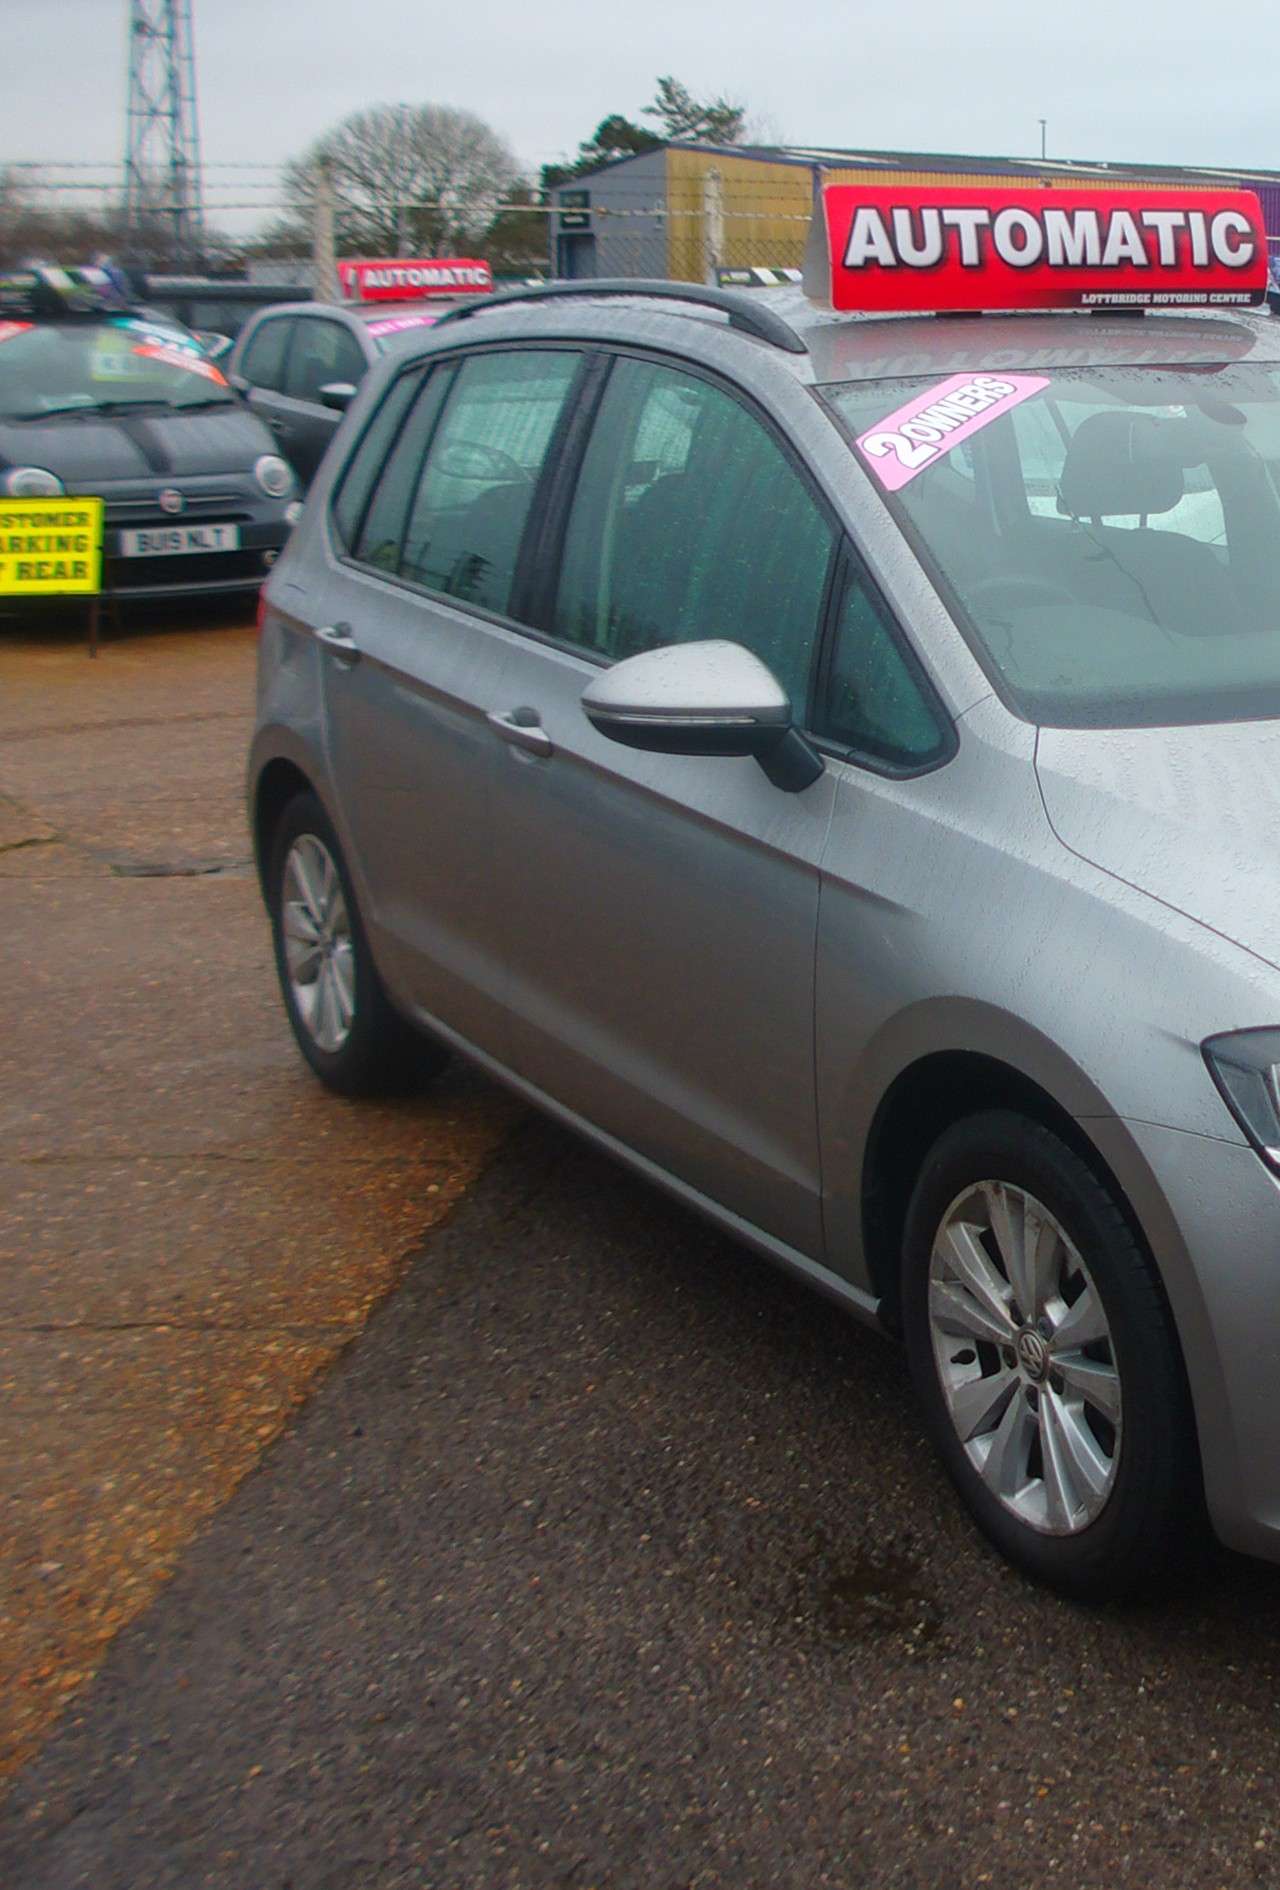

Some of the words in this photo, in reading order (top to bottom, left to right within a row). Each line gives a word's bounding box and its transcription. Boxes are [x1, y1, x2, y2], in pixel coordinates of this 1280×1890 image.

[843, 206, 1255, 269] AUTOMATIC
[365, 267, 491, 287] AUTOMATIC
[1082, 293, 1150, 304] LOTTBRIDGE
[1152, 293, 1206, 304] MOTORING
[1209, 293, 1251, 303] CENTRE
[898, 376, 1017, 442] OWNERS
[0, 512, 90, 528] STOMER
[0, 534, 88, 554] RKING
[16, 561, 88, 580] REAR
